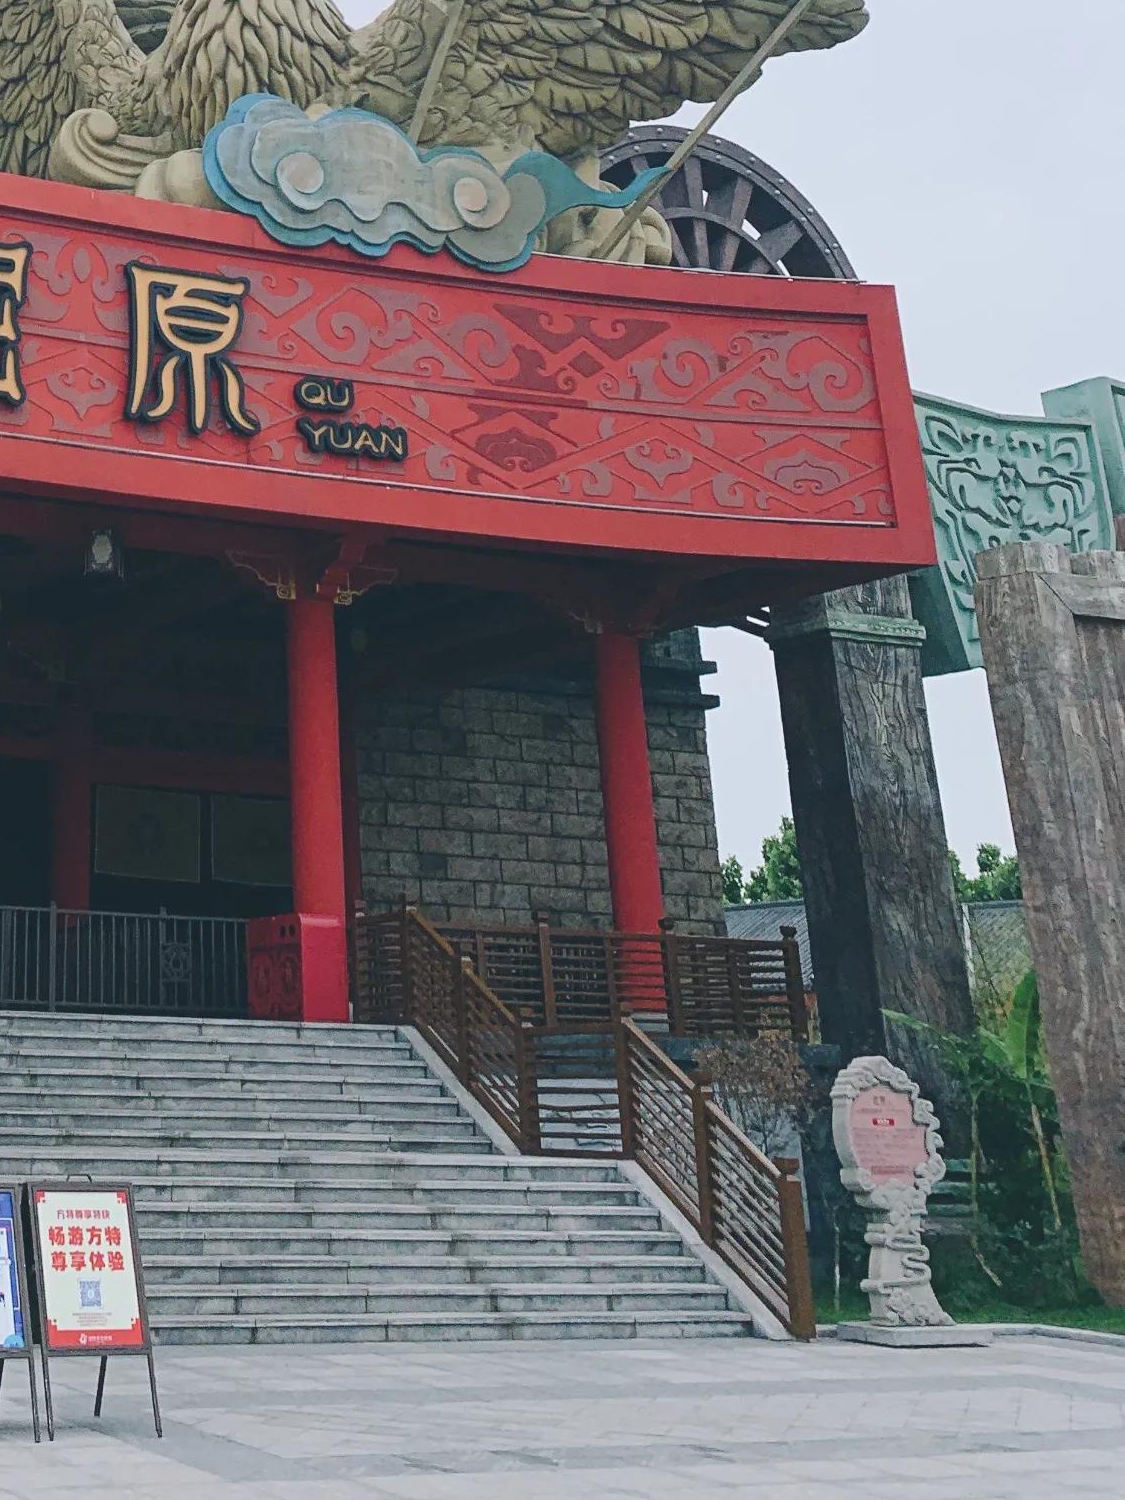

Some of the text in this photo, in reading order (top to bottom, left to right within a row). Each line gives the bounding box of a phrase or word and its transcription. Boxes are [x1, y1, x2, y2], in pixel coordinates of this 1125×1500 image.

[296, 379, 354, 411] QU
[300, 419, 406, 460] YUAN
[48, 1225, 122, 1246] 畅游方特
[51, 1251, 125, 1271] 尊享体验
